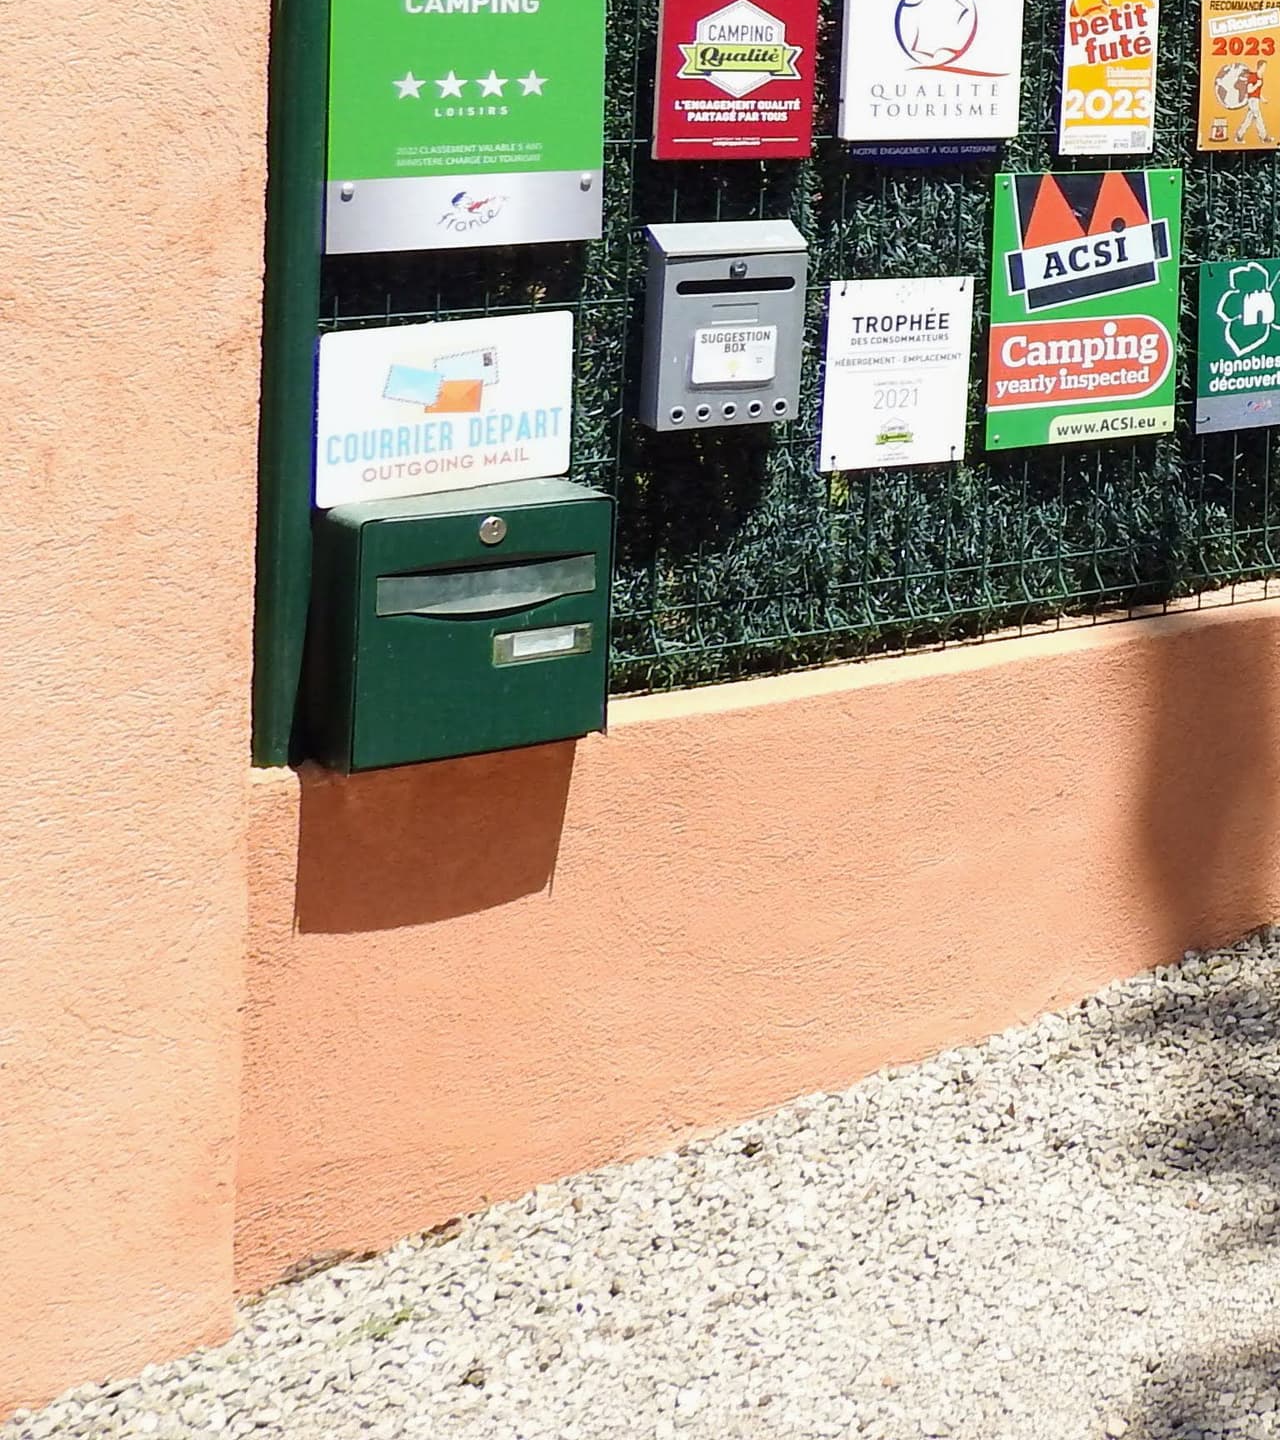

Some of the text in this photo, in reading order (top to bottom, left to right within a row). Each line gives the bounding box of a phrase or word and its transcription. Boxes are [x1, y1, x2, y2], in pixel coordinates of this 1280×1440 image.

[1266, 0, 1280, 10] PAR
[708, 24, 773, 42] CAMPING
[1069, 3, 1148, 46] petit
[1085, 30, 1151, 64] futé
[1212, 37, 1275, 56] 2023
[434, 106, 509, 117] LOISIRS
[675, 97, 801, 110] L'ENGAGEMENT QUALITÉ
[871, 103, 999, 117] TOURISME
[1065, 89, 1151, 119] 2023
[738, 111, 759, 122] PAR
[761, 111, 788, 122] TOUS
[419, 145, 475, 154] CLASSEMENT
[478, 144, 515, 152] VALABLE
[853, 147, 877, 155] NOTRE
[880, 146, 929, 155] ENGAGEMENT
[940, 146, 958, 154] VOUS
[961, 145, 997, 153] SATISFAIRE
[852, 307, 950, 334] TROPHÉE
[700, 330, 771, 344] SUGGESTION
[851, 333, 950, 346] DES CONSOMMATEURS
[1001, 321, 1159, 369] Camping
[724, 343, 746, 353] BOX
[903, 353, 962, 364] EMPLACEMENT
[996, 366, 1150, 398] yearly inspected
[873, 388, 919, 410] 2021
[1057, 416, 1156, 437] www.ACSI.eu
[325, 407, 563, 465] COURRIER DÉPART
[361, 447, 531, 482] OUTGOING MAIL
